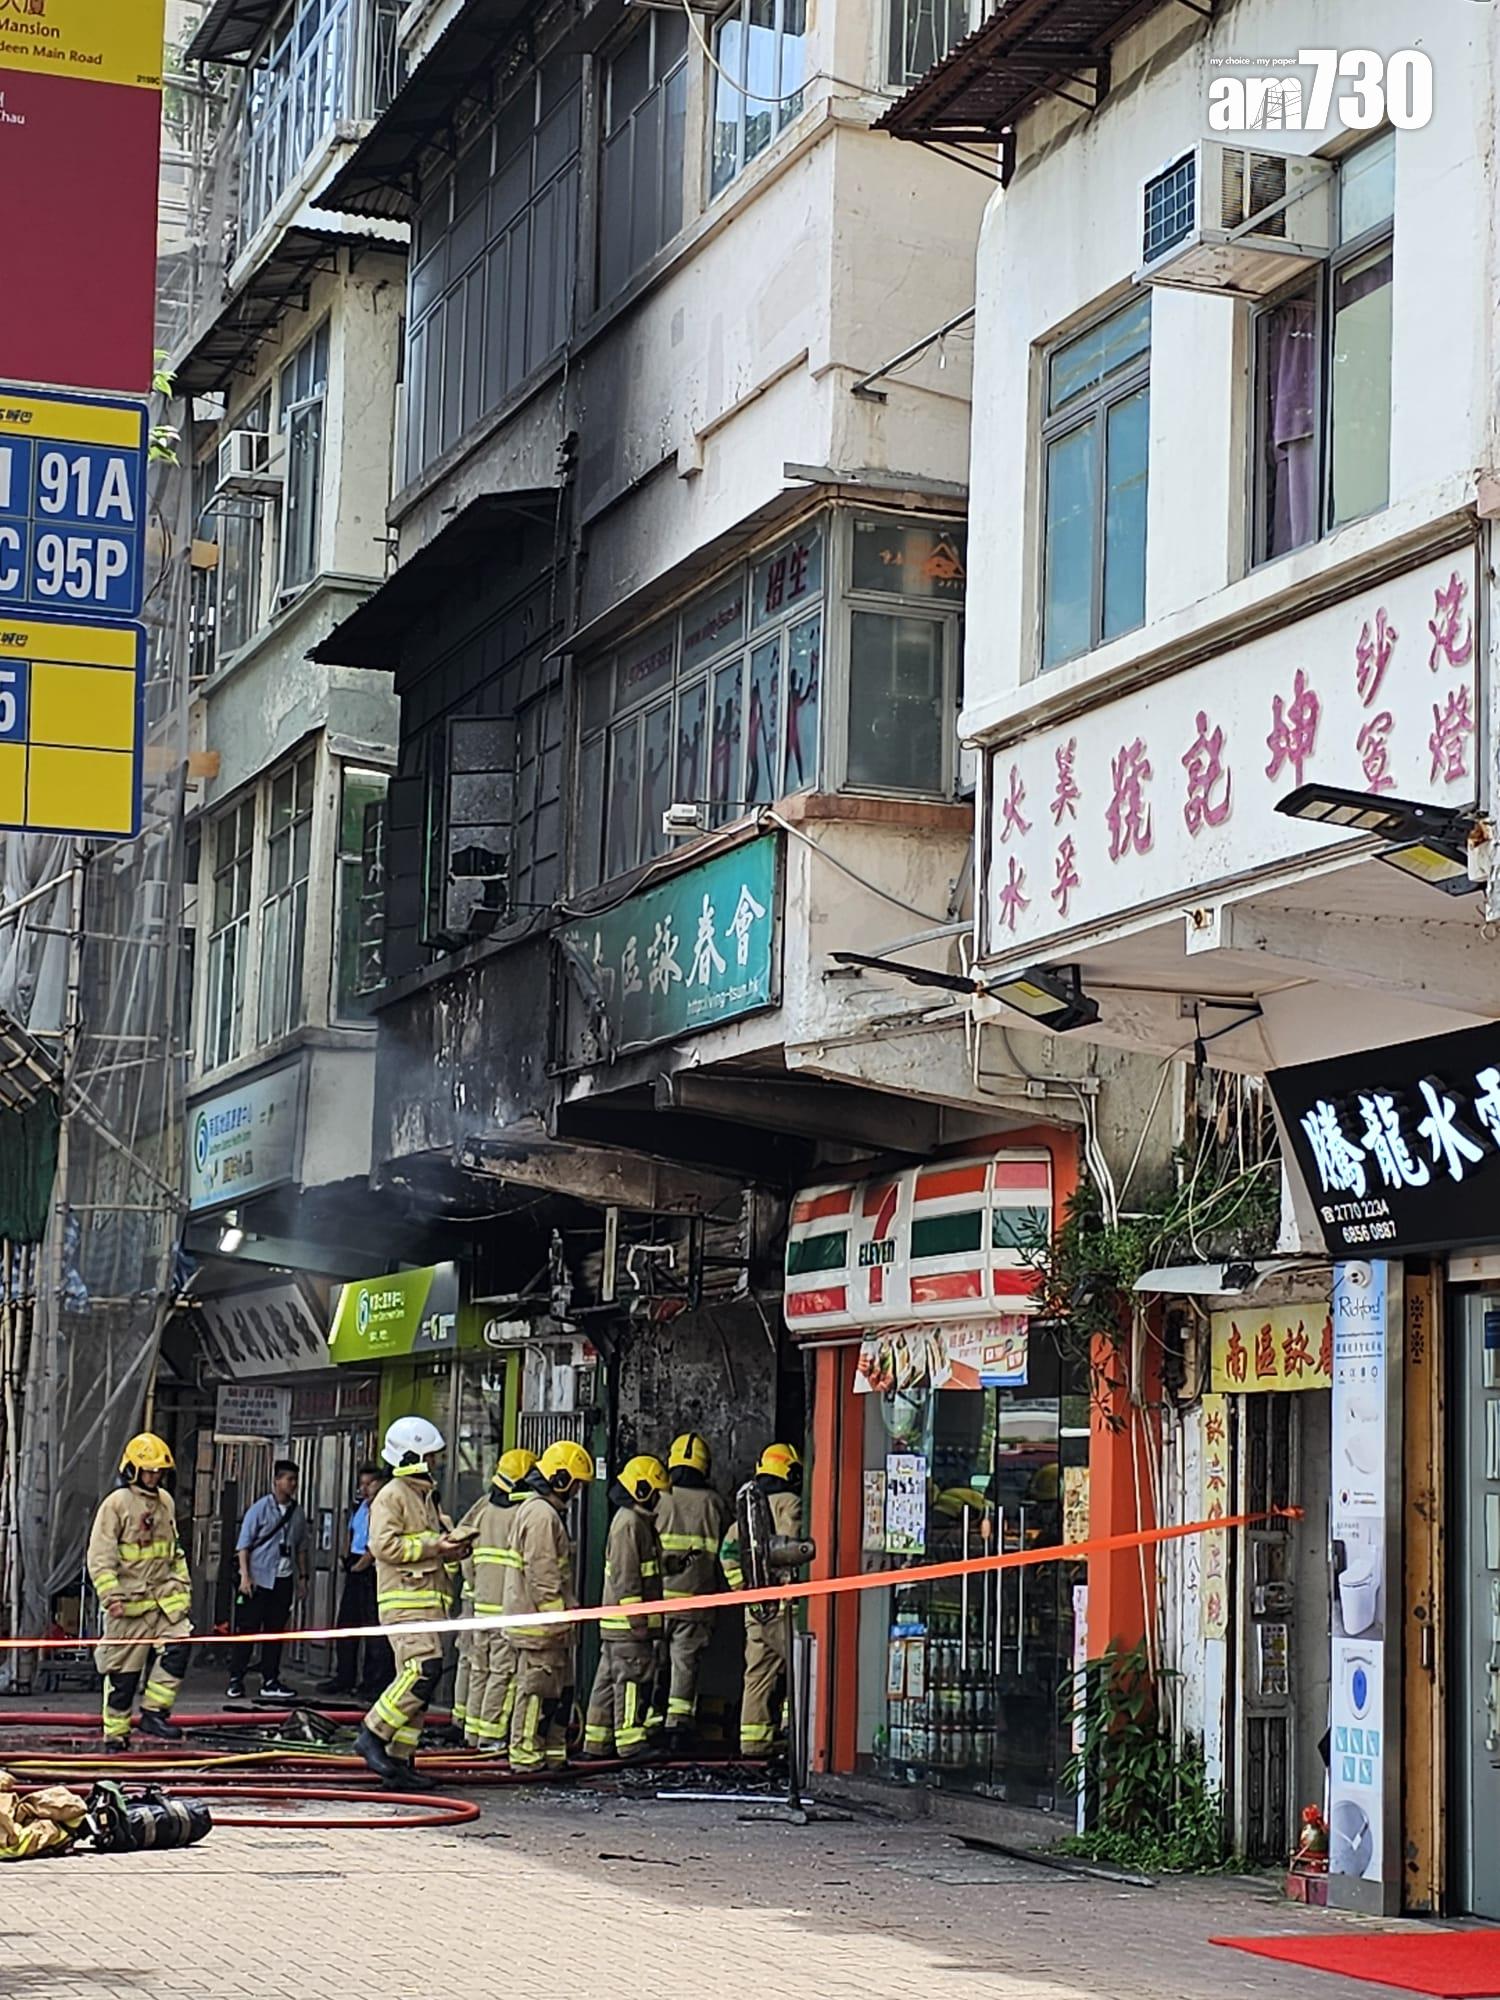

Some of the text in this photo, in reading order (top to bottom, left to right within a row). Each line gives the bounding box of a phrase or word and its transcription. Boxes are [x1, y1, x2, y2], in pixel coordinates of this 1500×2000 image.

[0, 17, 61, 39] Mansion
[33, 45, 66, 60] Main
[70, 50, 103, 65] Road
[39, 451, 134, 522] 91A
[36, 534, 129, 601] 95P
[1334, 1198, 1390, 1221] 2770 2234
